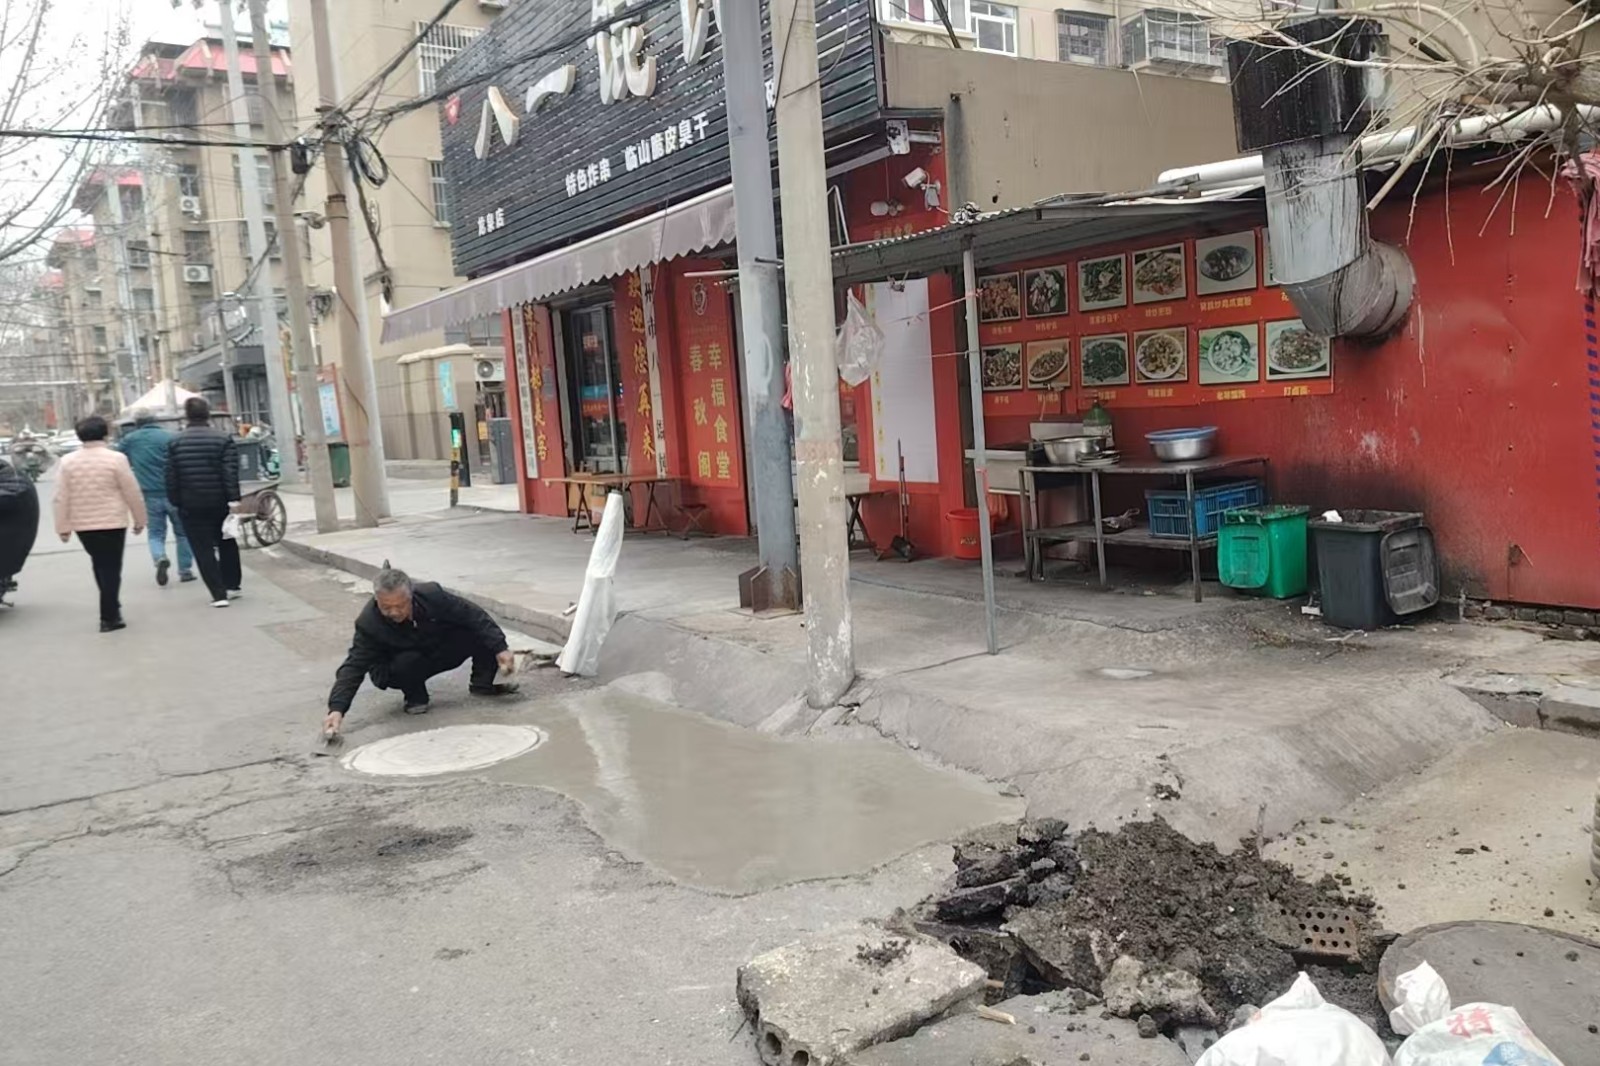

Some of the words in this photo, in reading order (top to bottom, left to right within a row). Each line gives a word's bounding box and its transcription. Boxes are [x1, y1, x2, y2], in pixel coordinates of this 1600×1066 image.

[565, 157, 612, 198] 特色炸串
[689, 345, 712, 479] 春秋阁
[708, 343, 731, 479] 幸福食堂
